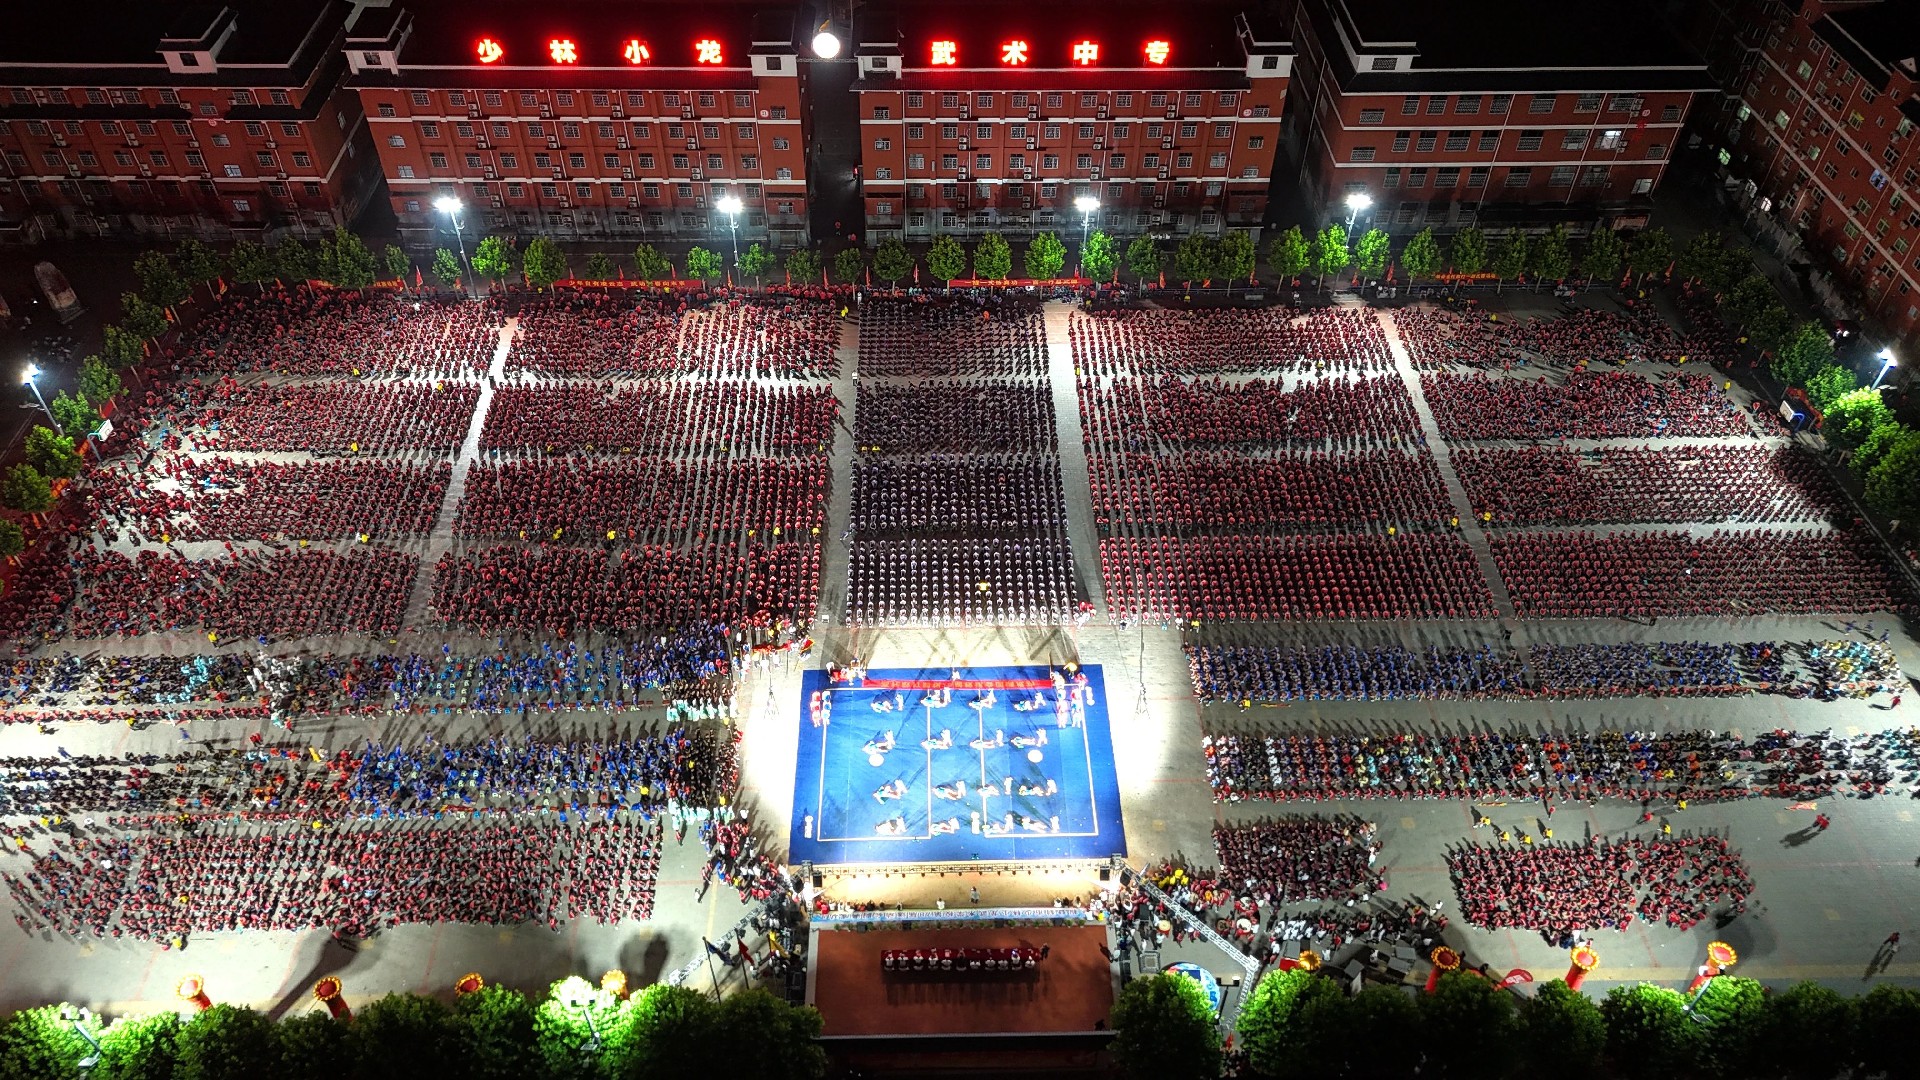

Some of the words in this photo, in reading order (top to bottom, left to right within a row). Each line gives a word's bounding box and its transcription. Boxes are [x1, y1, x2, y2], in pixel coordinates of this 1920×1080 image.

[477, 39, 723, 64] 少林小龙
[931, 40, 1170, 65] 武术中专
